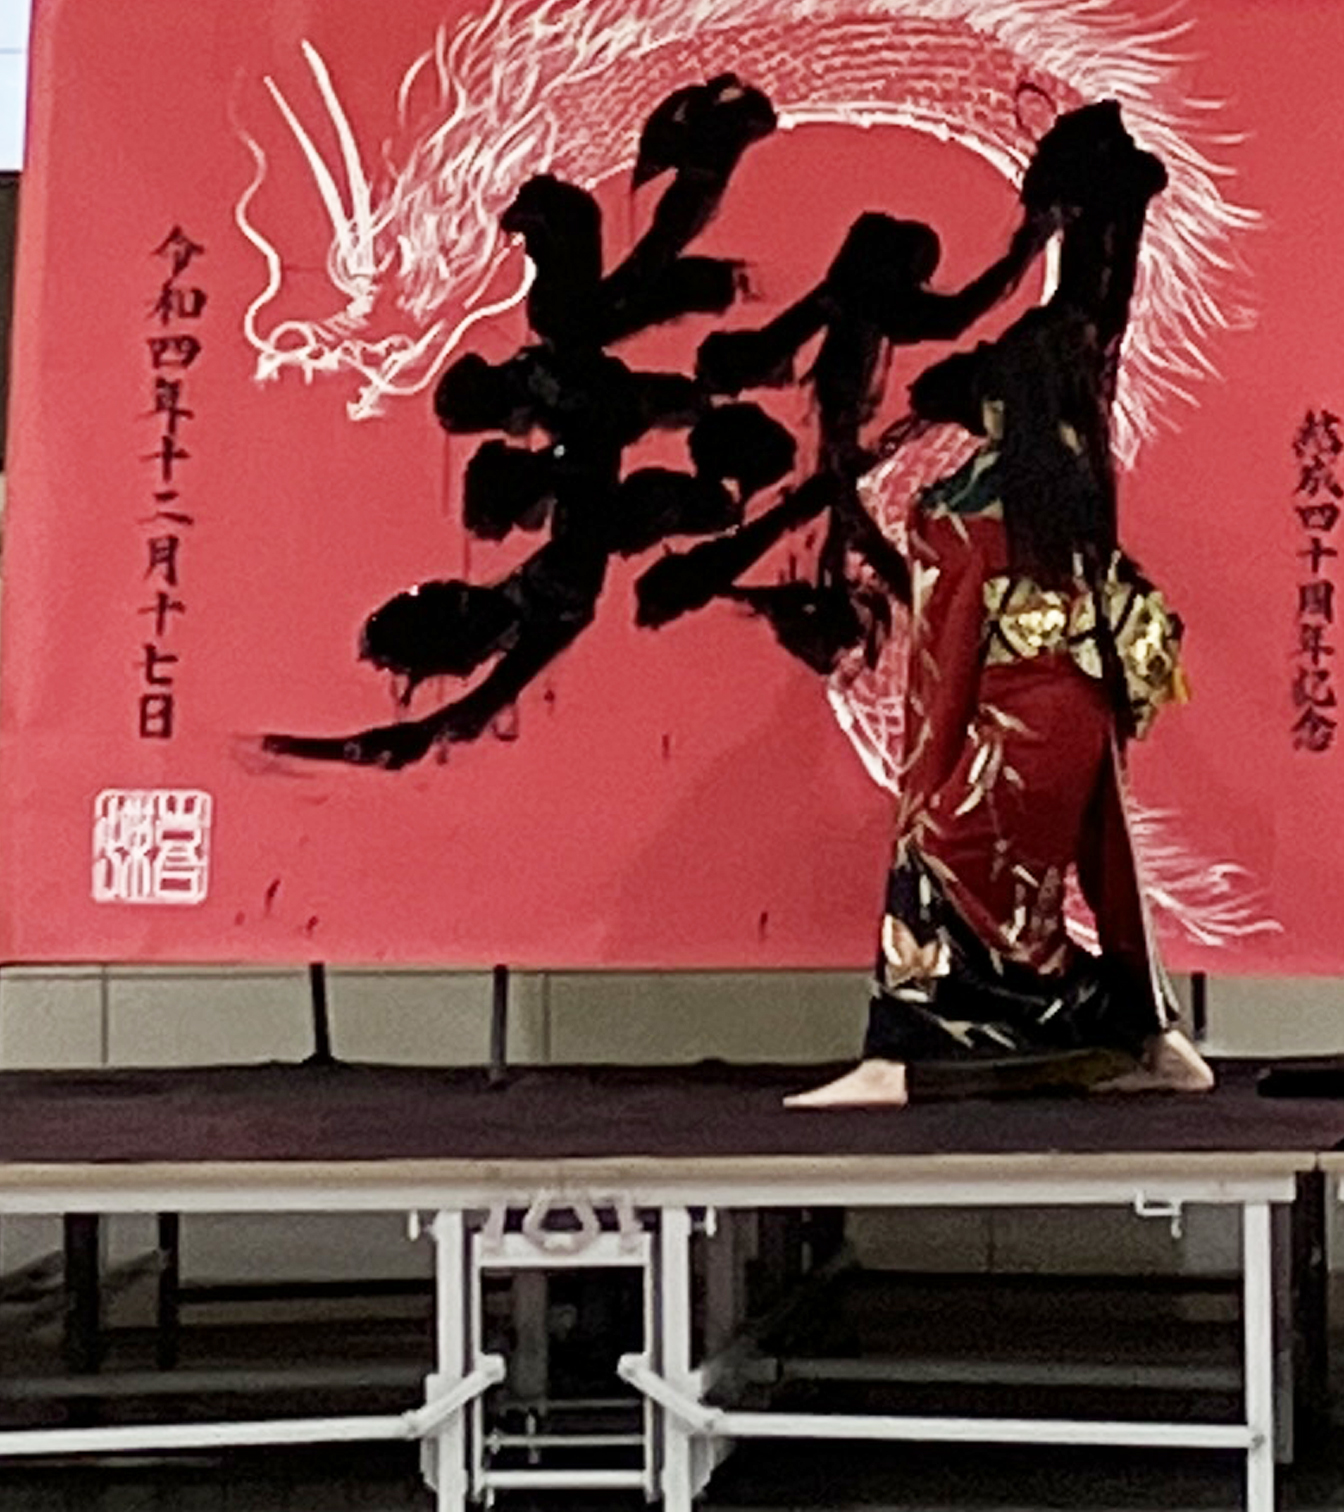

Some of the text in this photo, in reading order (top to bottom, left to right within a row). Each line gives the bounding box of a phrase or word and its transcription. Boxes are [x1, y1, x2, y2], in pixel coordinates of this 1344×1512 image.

[137, 225, 209, 742] 令和四年十二月十七日
